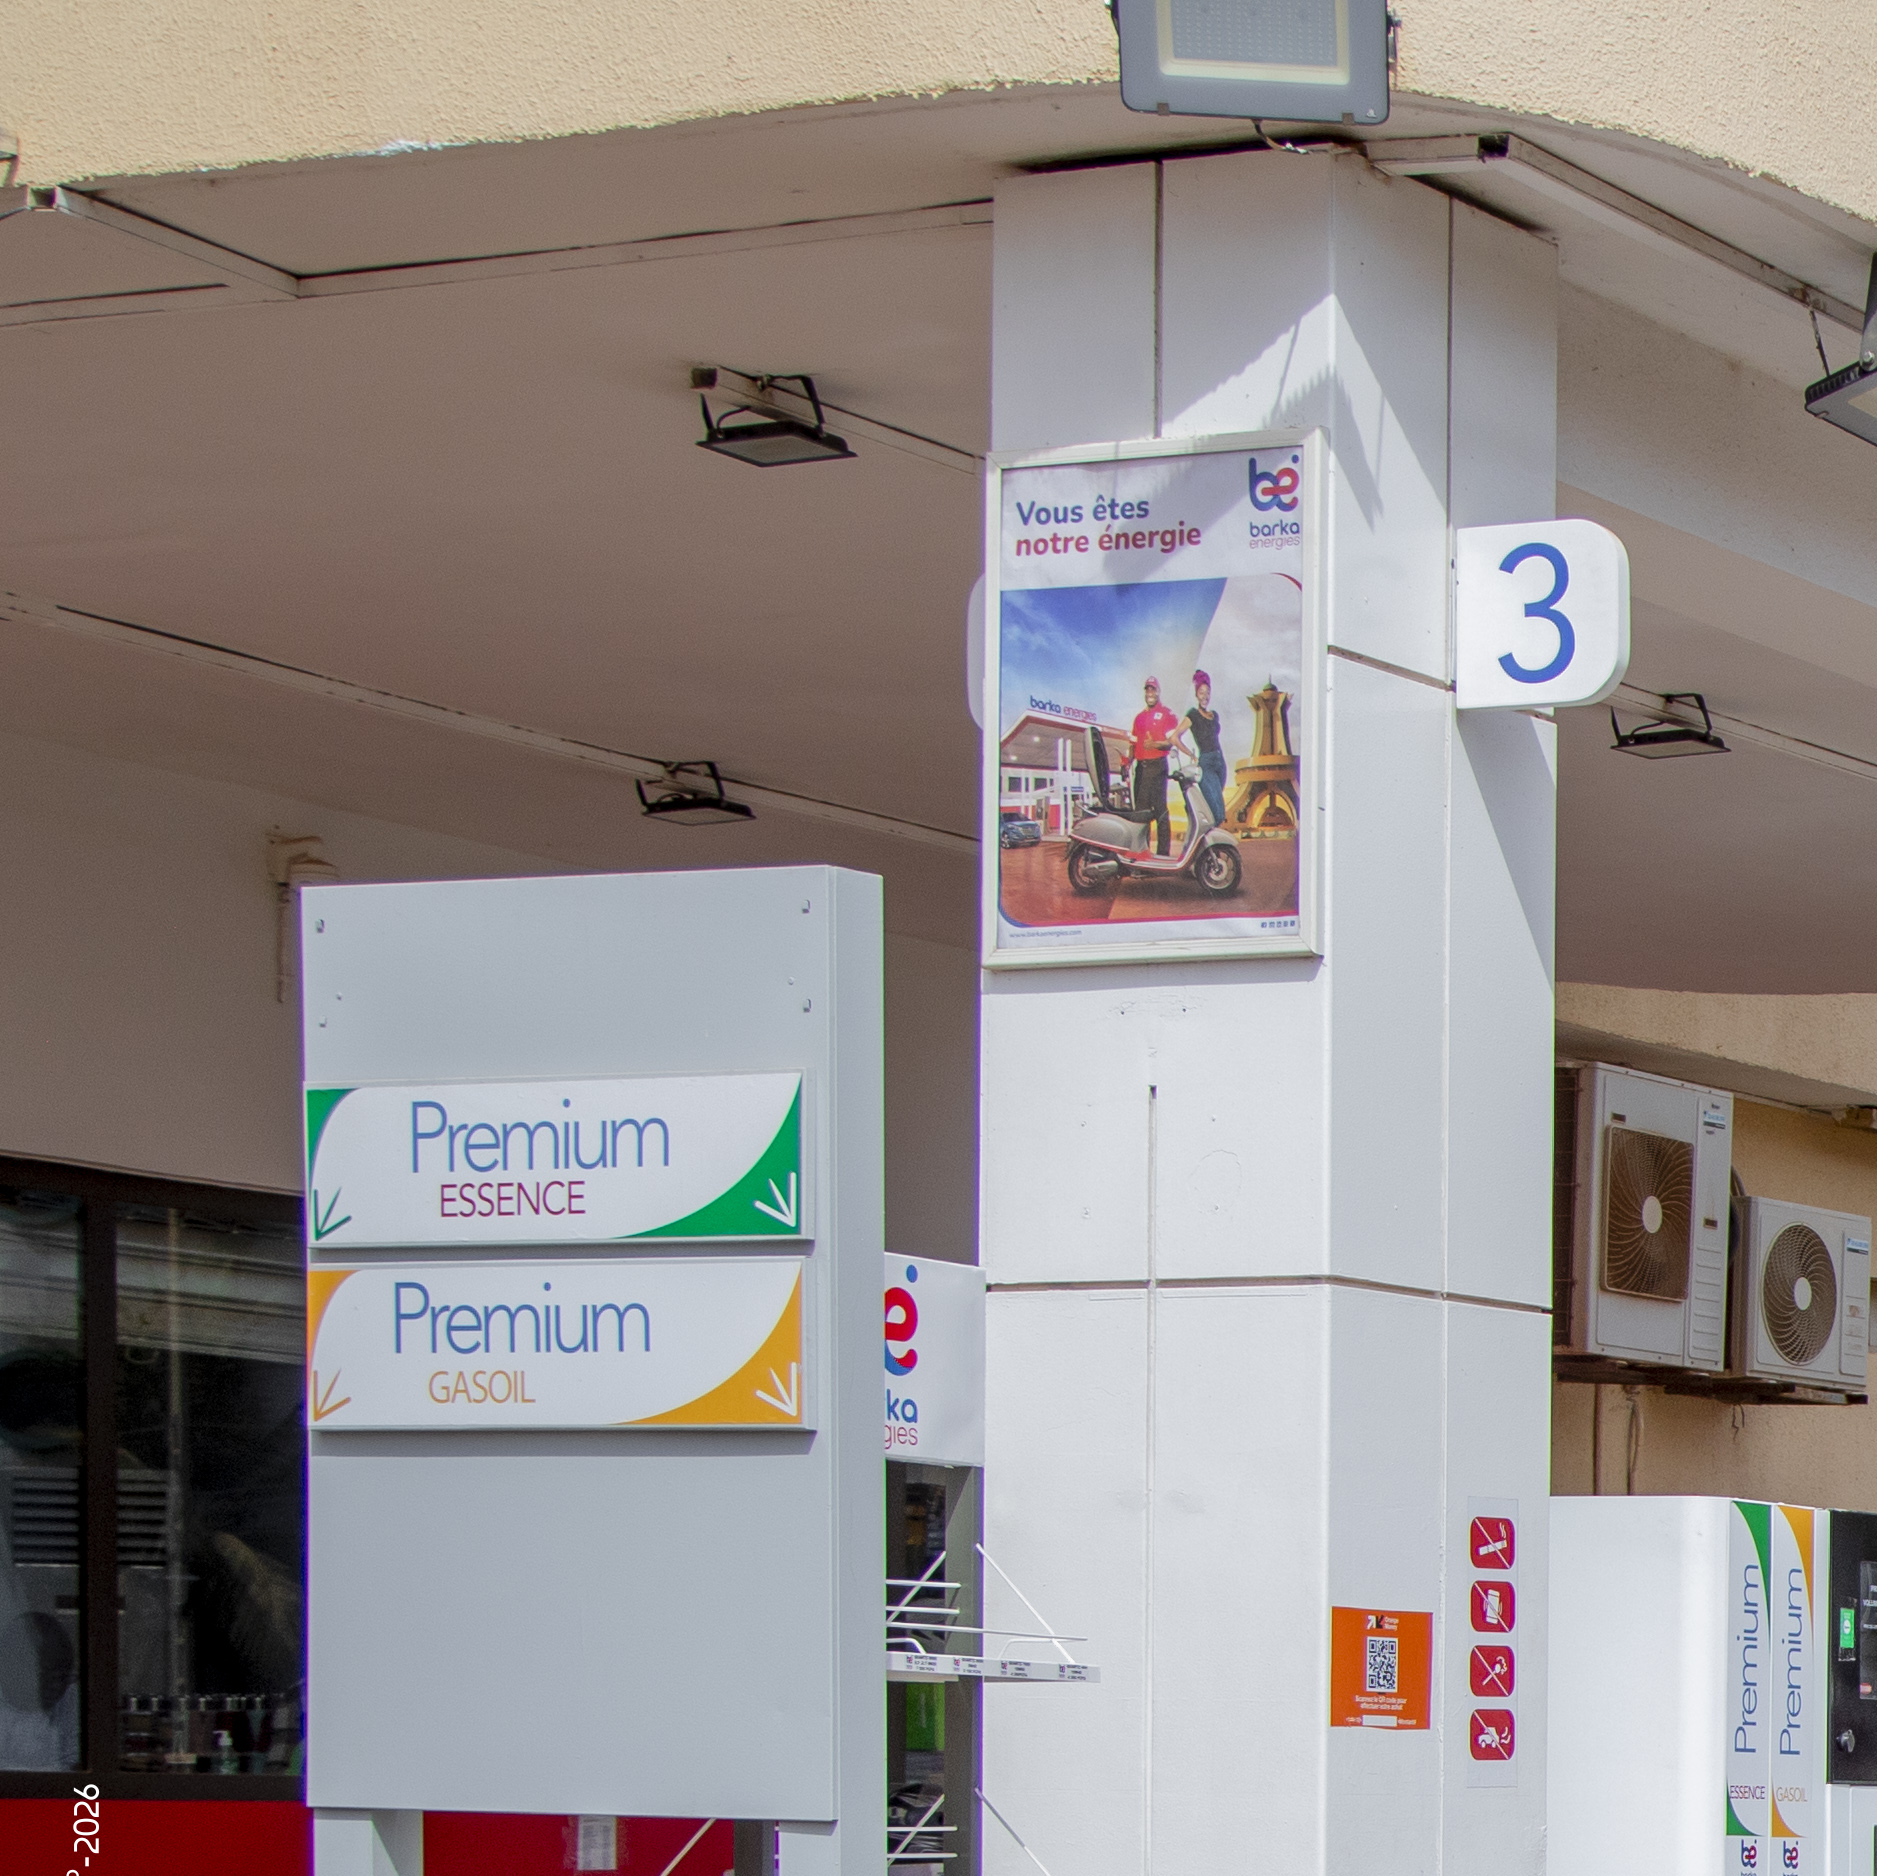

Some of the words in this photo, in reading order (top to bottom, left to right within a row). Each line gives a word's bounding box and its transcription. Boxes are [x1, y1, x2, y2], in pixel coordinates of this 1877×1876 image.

[1016, 501, 1083, 526] Vous
[1092, 494, 1150, 521] êtes
[1015, 532, 1089, 557] notre
[1097, 520, 1202, 554] énergie
[1249, 518, 1300, 538] barka
[1249, 534, 1300, 551] energies
[1498, 543, 1576, 684] 3
[1029, 694, 1062, 715] barka
[1063, 706, 1097, 722] energies
[411, 1098, 669, 1174] Premium
[440, 1180, 586, 1218] ESSENCE
[394, 1281, 650, 1354] Premium
[428, 1370, 536, 1404] GASOIL
[1734, 1564, 1760, 1753] Premium
[1779, 1567, 1803, 1756] Premium
[1729, 1784, 1766, 1801] ESSENCE
[1776, 1786, 1808, 1802] GASOIL
